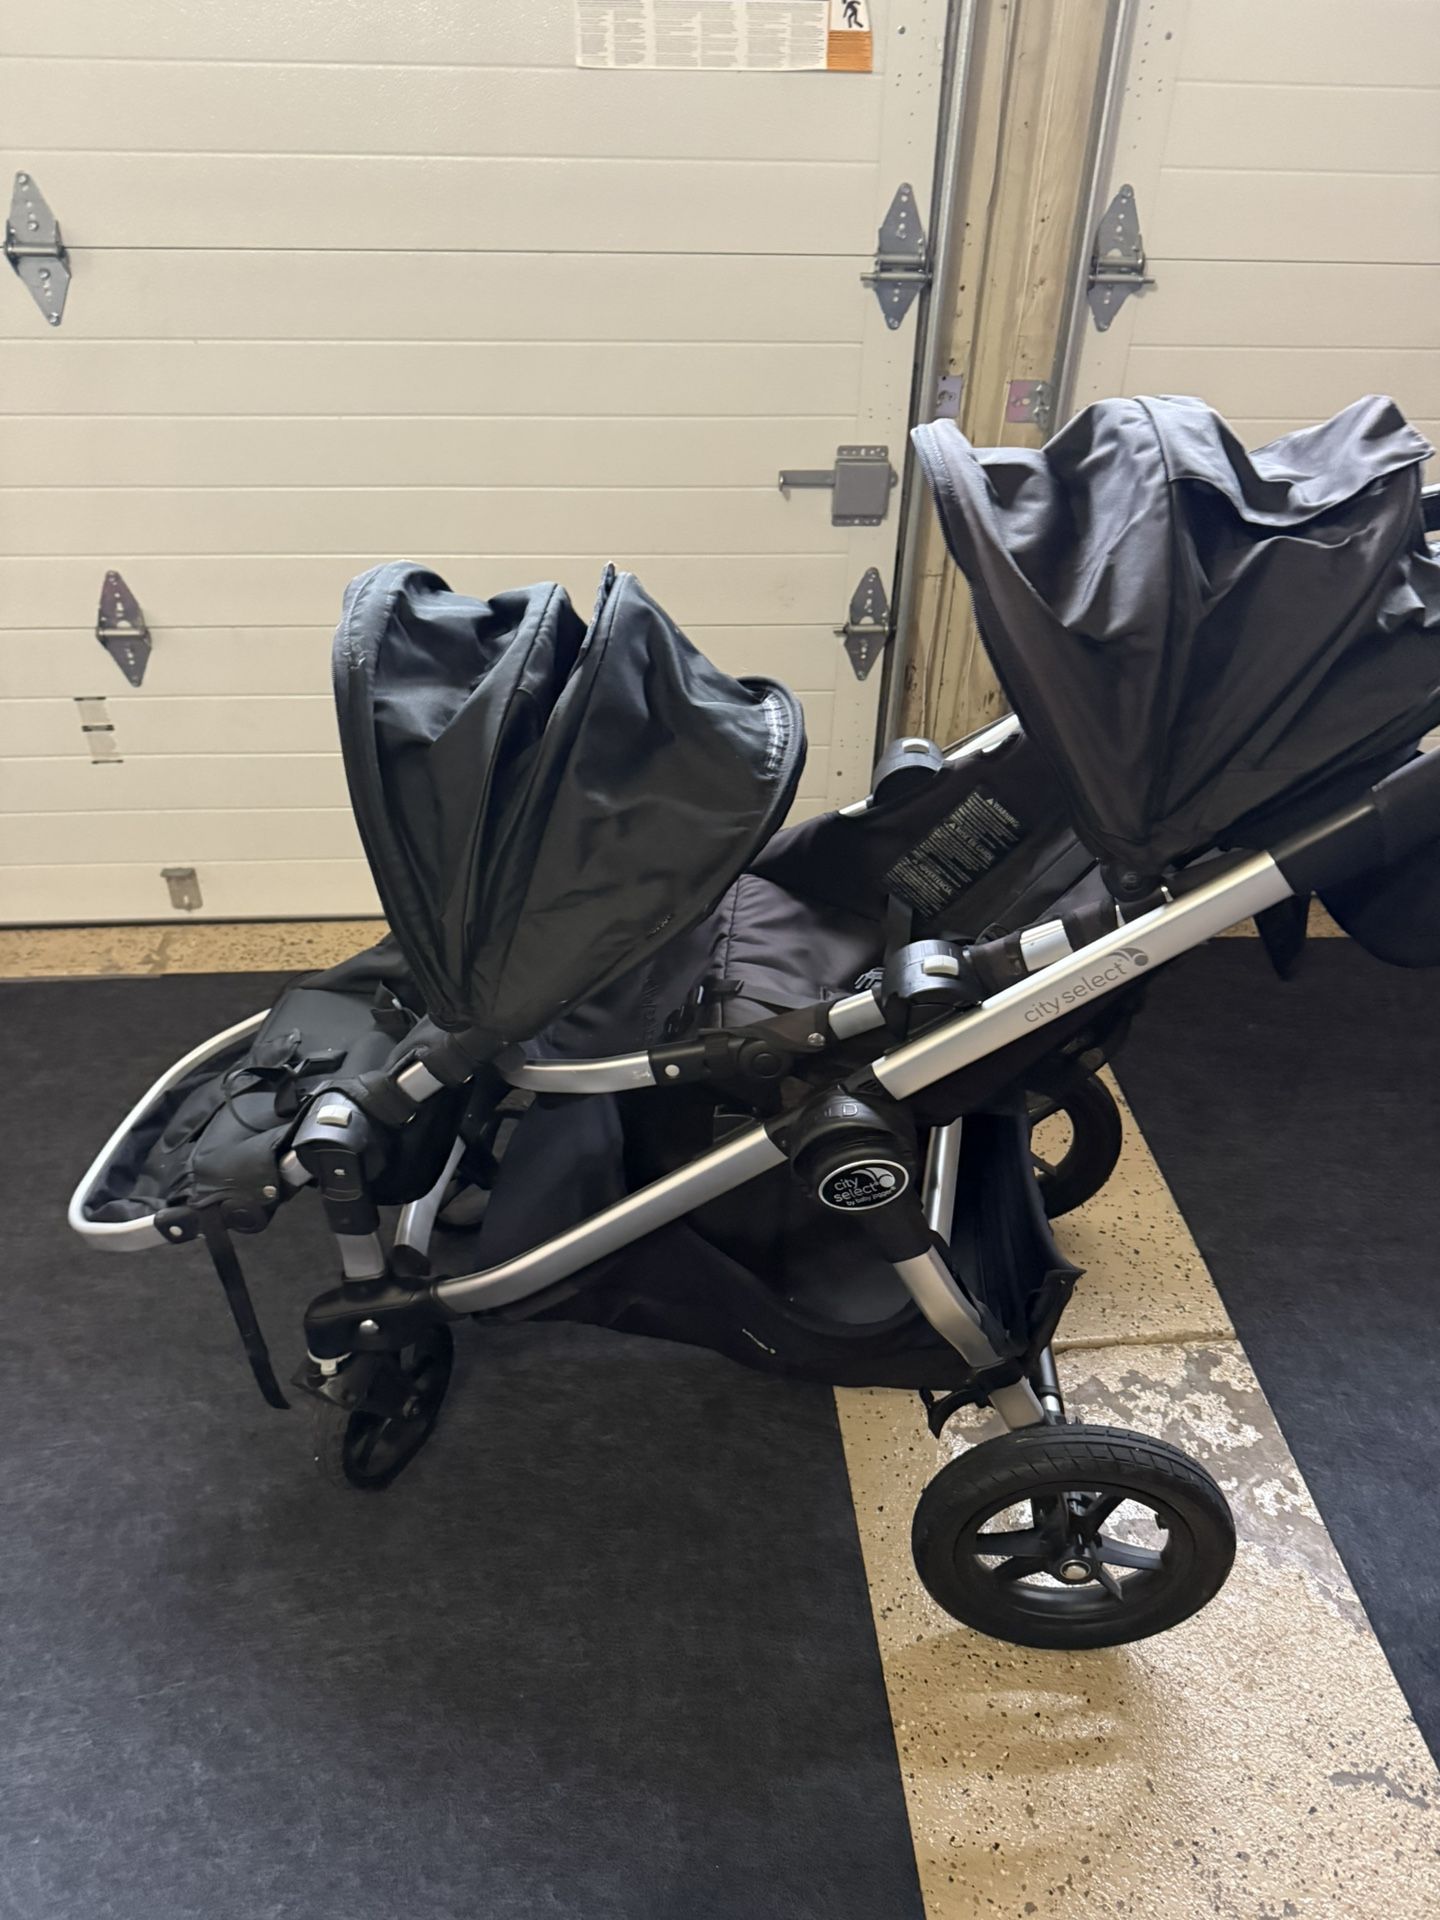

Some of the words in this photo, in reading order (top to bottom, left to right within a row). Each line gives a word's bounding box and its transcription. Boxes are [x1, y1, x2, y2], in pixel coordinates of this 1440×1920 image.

[1024, 997, 1059, 1022] city
[1062, 962, 1127, 1004] select
[834, 1177, 858, 1191] city
[834, 1183, 878, 1202] select
